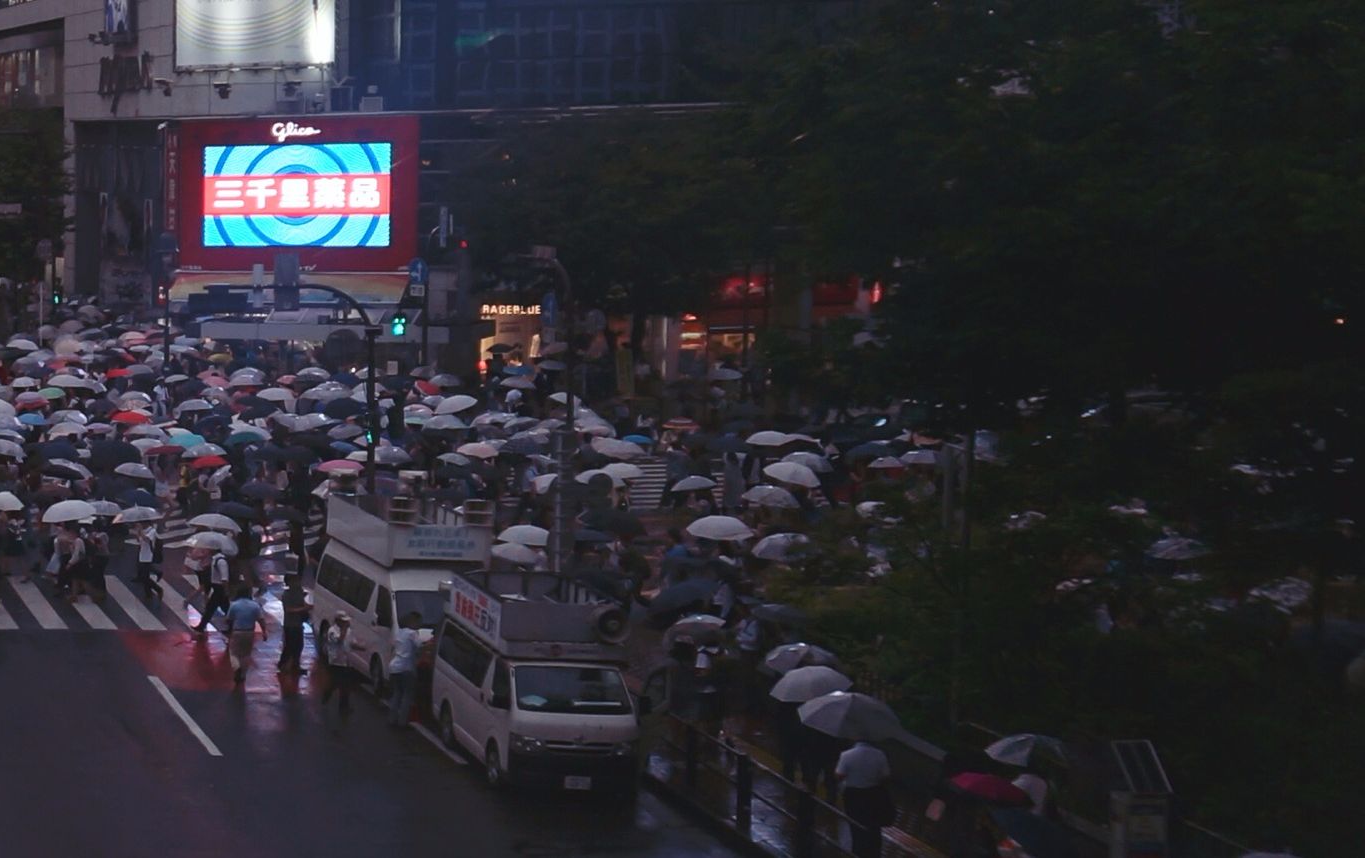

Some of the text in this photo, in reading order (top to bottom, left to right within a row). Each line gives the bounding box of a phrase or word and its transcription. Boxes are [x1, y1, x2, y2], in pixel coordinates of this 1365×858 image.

[271, 121, 321, 142] Glico
[213, 178, 381, 209] 三千里薬品
[481, 304, 542, 315] RAGEBLUE
